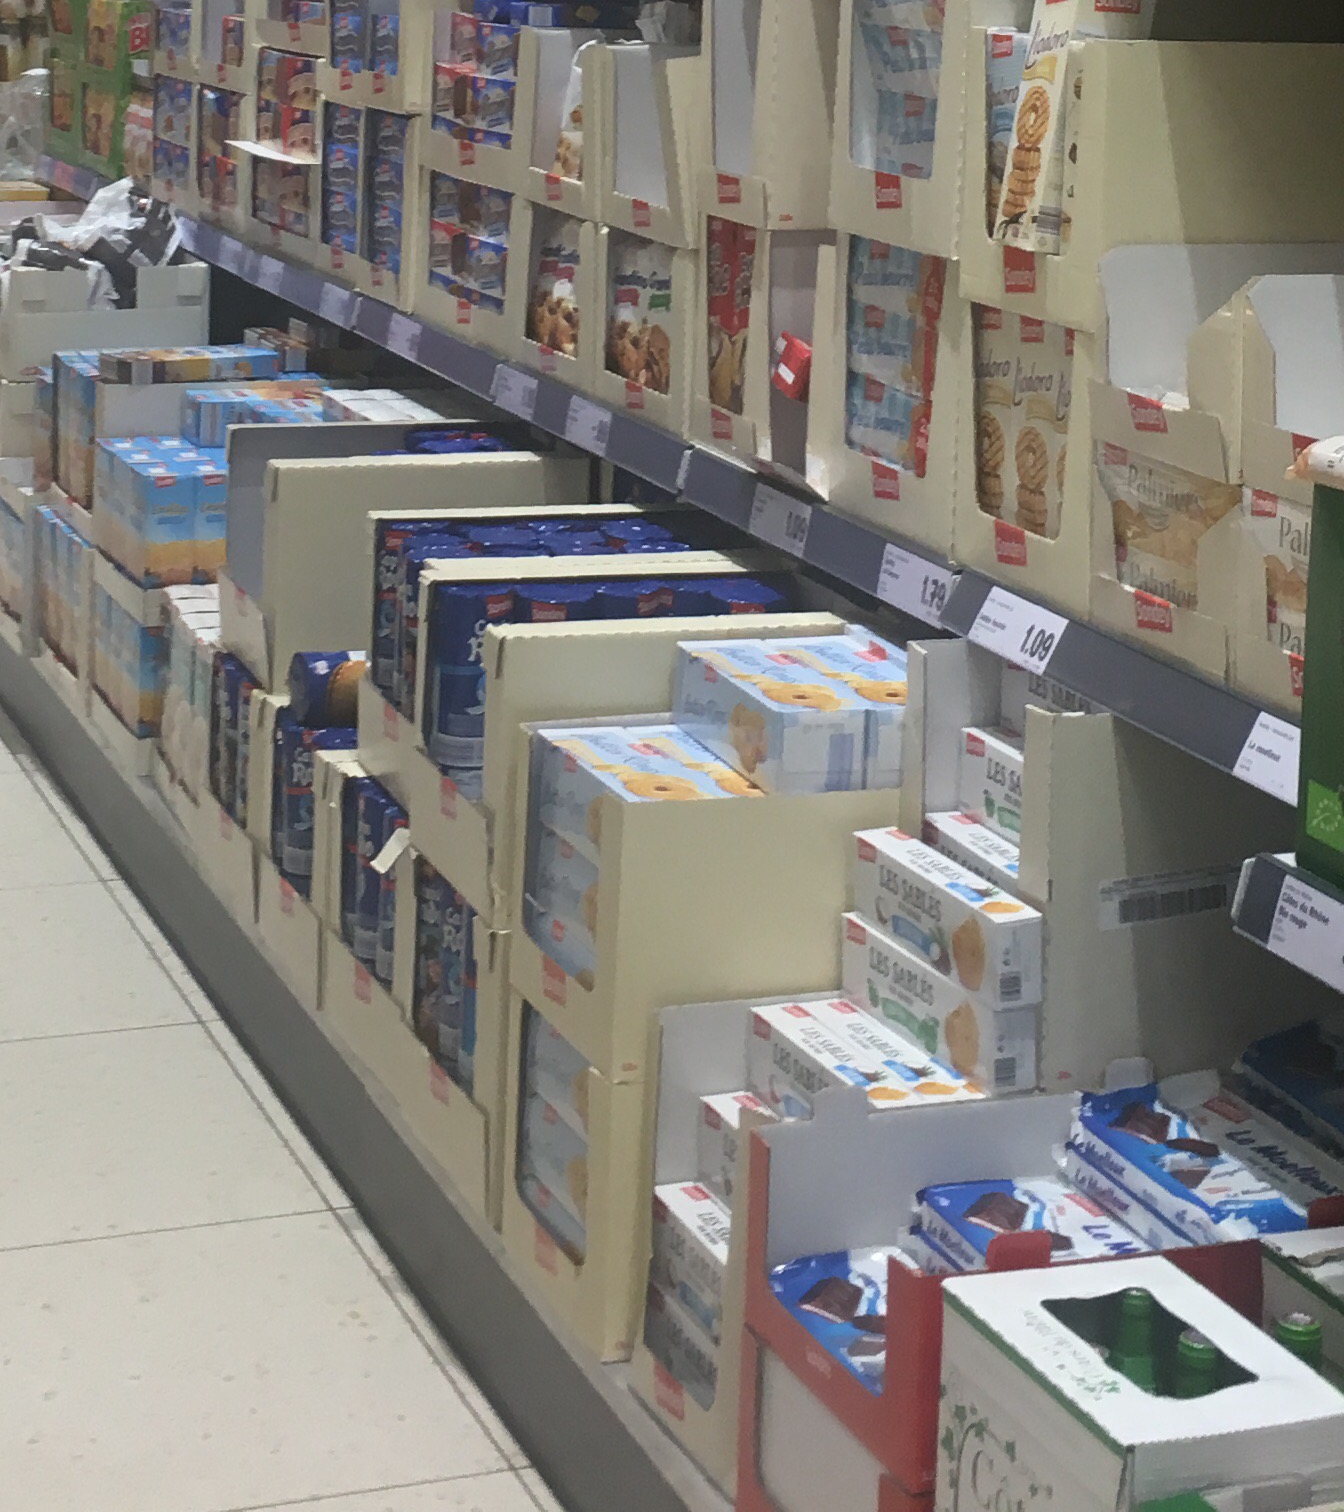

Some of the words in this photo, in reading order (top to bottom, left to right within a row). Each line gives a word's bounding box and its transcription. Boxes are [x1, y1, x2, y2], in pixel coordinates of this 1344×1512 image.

[1019, 623, 1056, 663] 1.09
[987, 757, 1006, 786] LES
[879, 864, 899, 896] LES
[869, 946, 891, 978] LES
